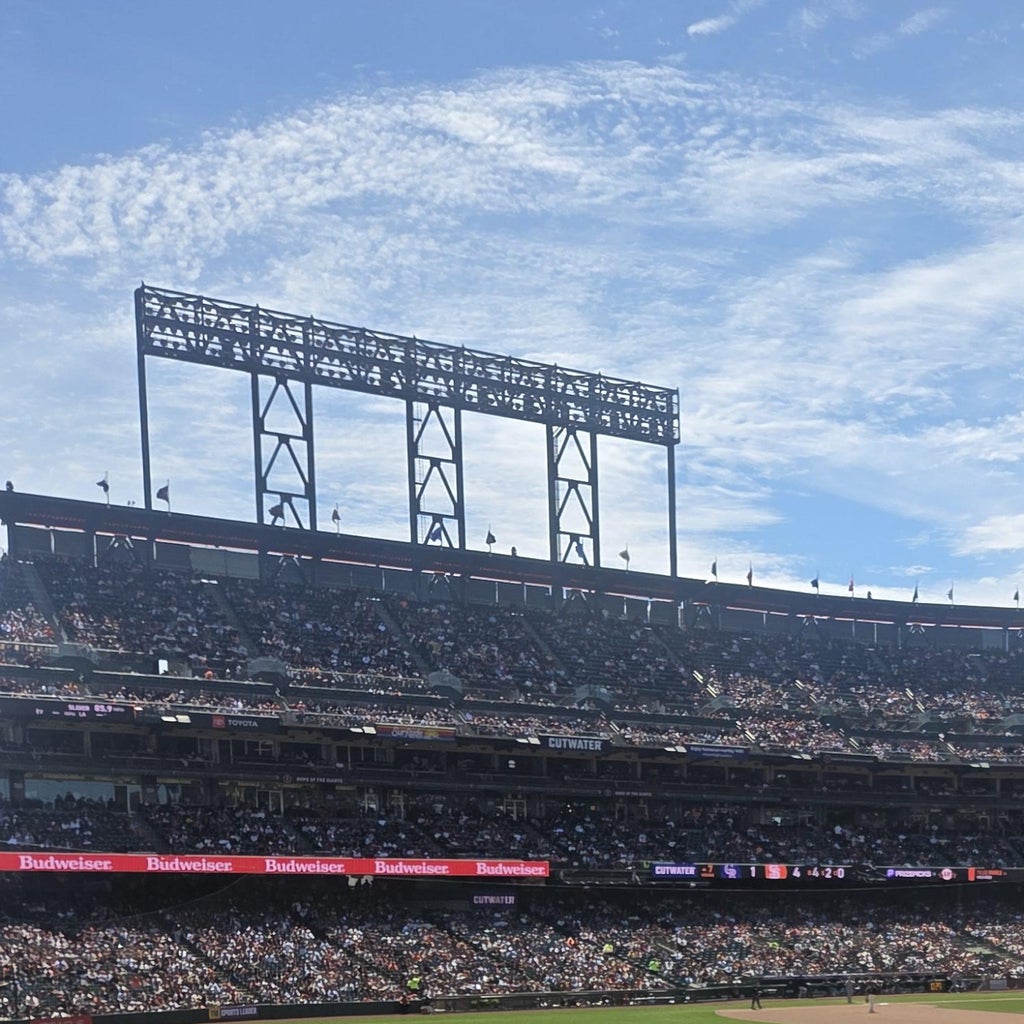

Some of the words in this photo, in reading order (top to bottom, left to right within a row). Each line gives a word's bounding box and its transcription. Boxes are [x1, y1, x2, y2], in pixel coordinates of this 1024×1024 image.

[228, 719, 258, 728] TOYOTA
[548, 737, 602, 751] CUTWATER
[19, 855, 112, 871] Budweiser
[146, 855, 233, 872] Budweiser
[264, 859, 345, 873] Budweiser
[374, 860, 449, 874] Budweiser
[476, 861, 546, 876] Budweiser
[655, 866, 696, 875] CUTWATER
[750, 866, 756, 878] 1
[792, 866, 801, 878] 4
[812, 867, 819, 878] 4
[825, 867, 832, 879] 2
[837, 867, 845, 879] 0
[221, 1008, 239, 1017] SPORTS
